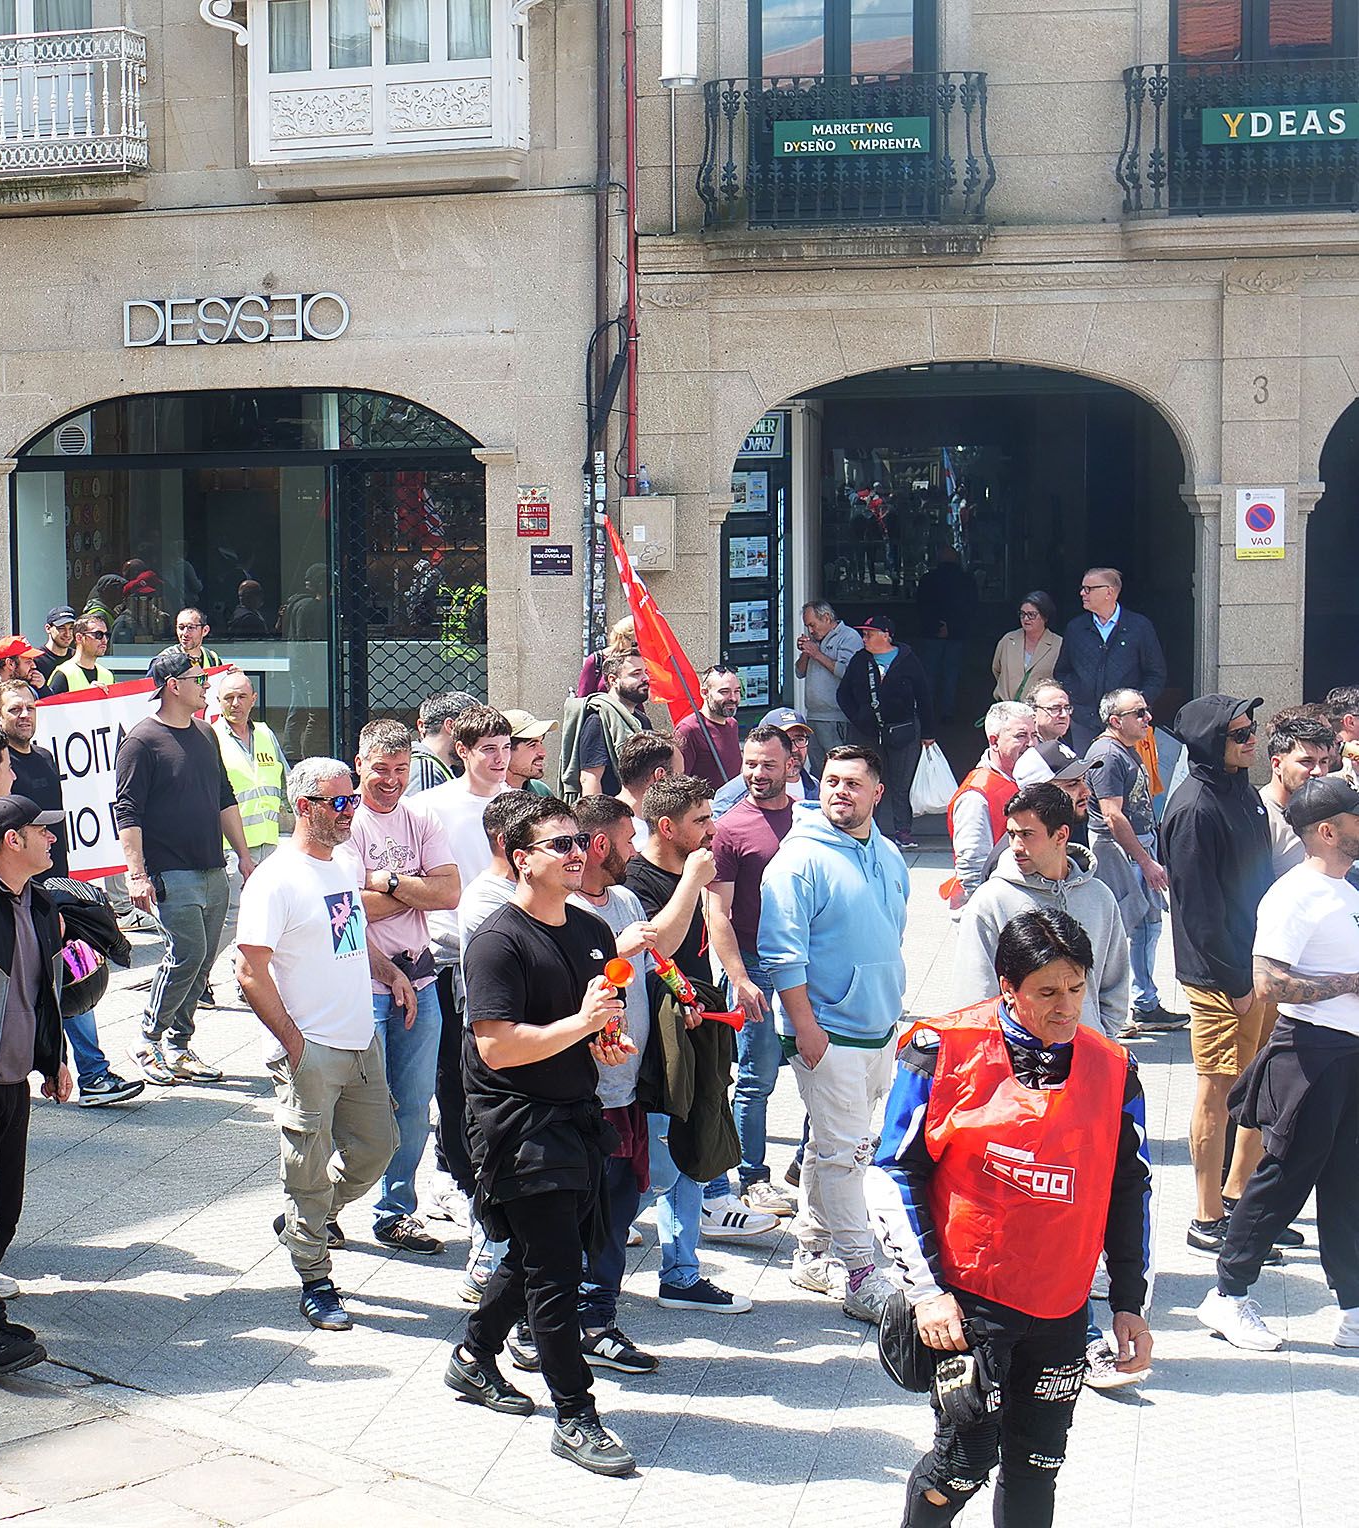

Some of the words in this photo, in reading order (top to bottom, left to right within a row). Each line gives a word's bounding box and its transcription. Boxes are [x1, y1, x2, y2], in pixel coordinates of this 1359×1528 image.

[812, 122, 893, 135] MARKETYNG
[1222, 108, 1346, 138] YDEAS
[784, 138, 836, 153] DYSEÑO
[850, 138, 921, 150] YMPRENTA
[1253, 375, 1269, 404] 3
[1250, 537, 1272, 546] VAO
